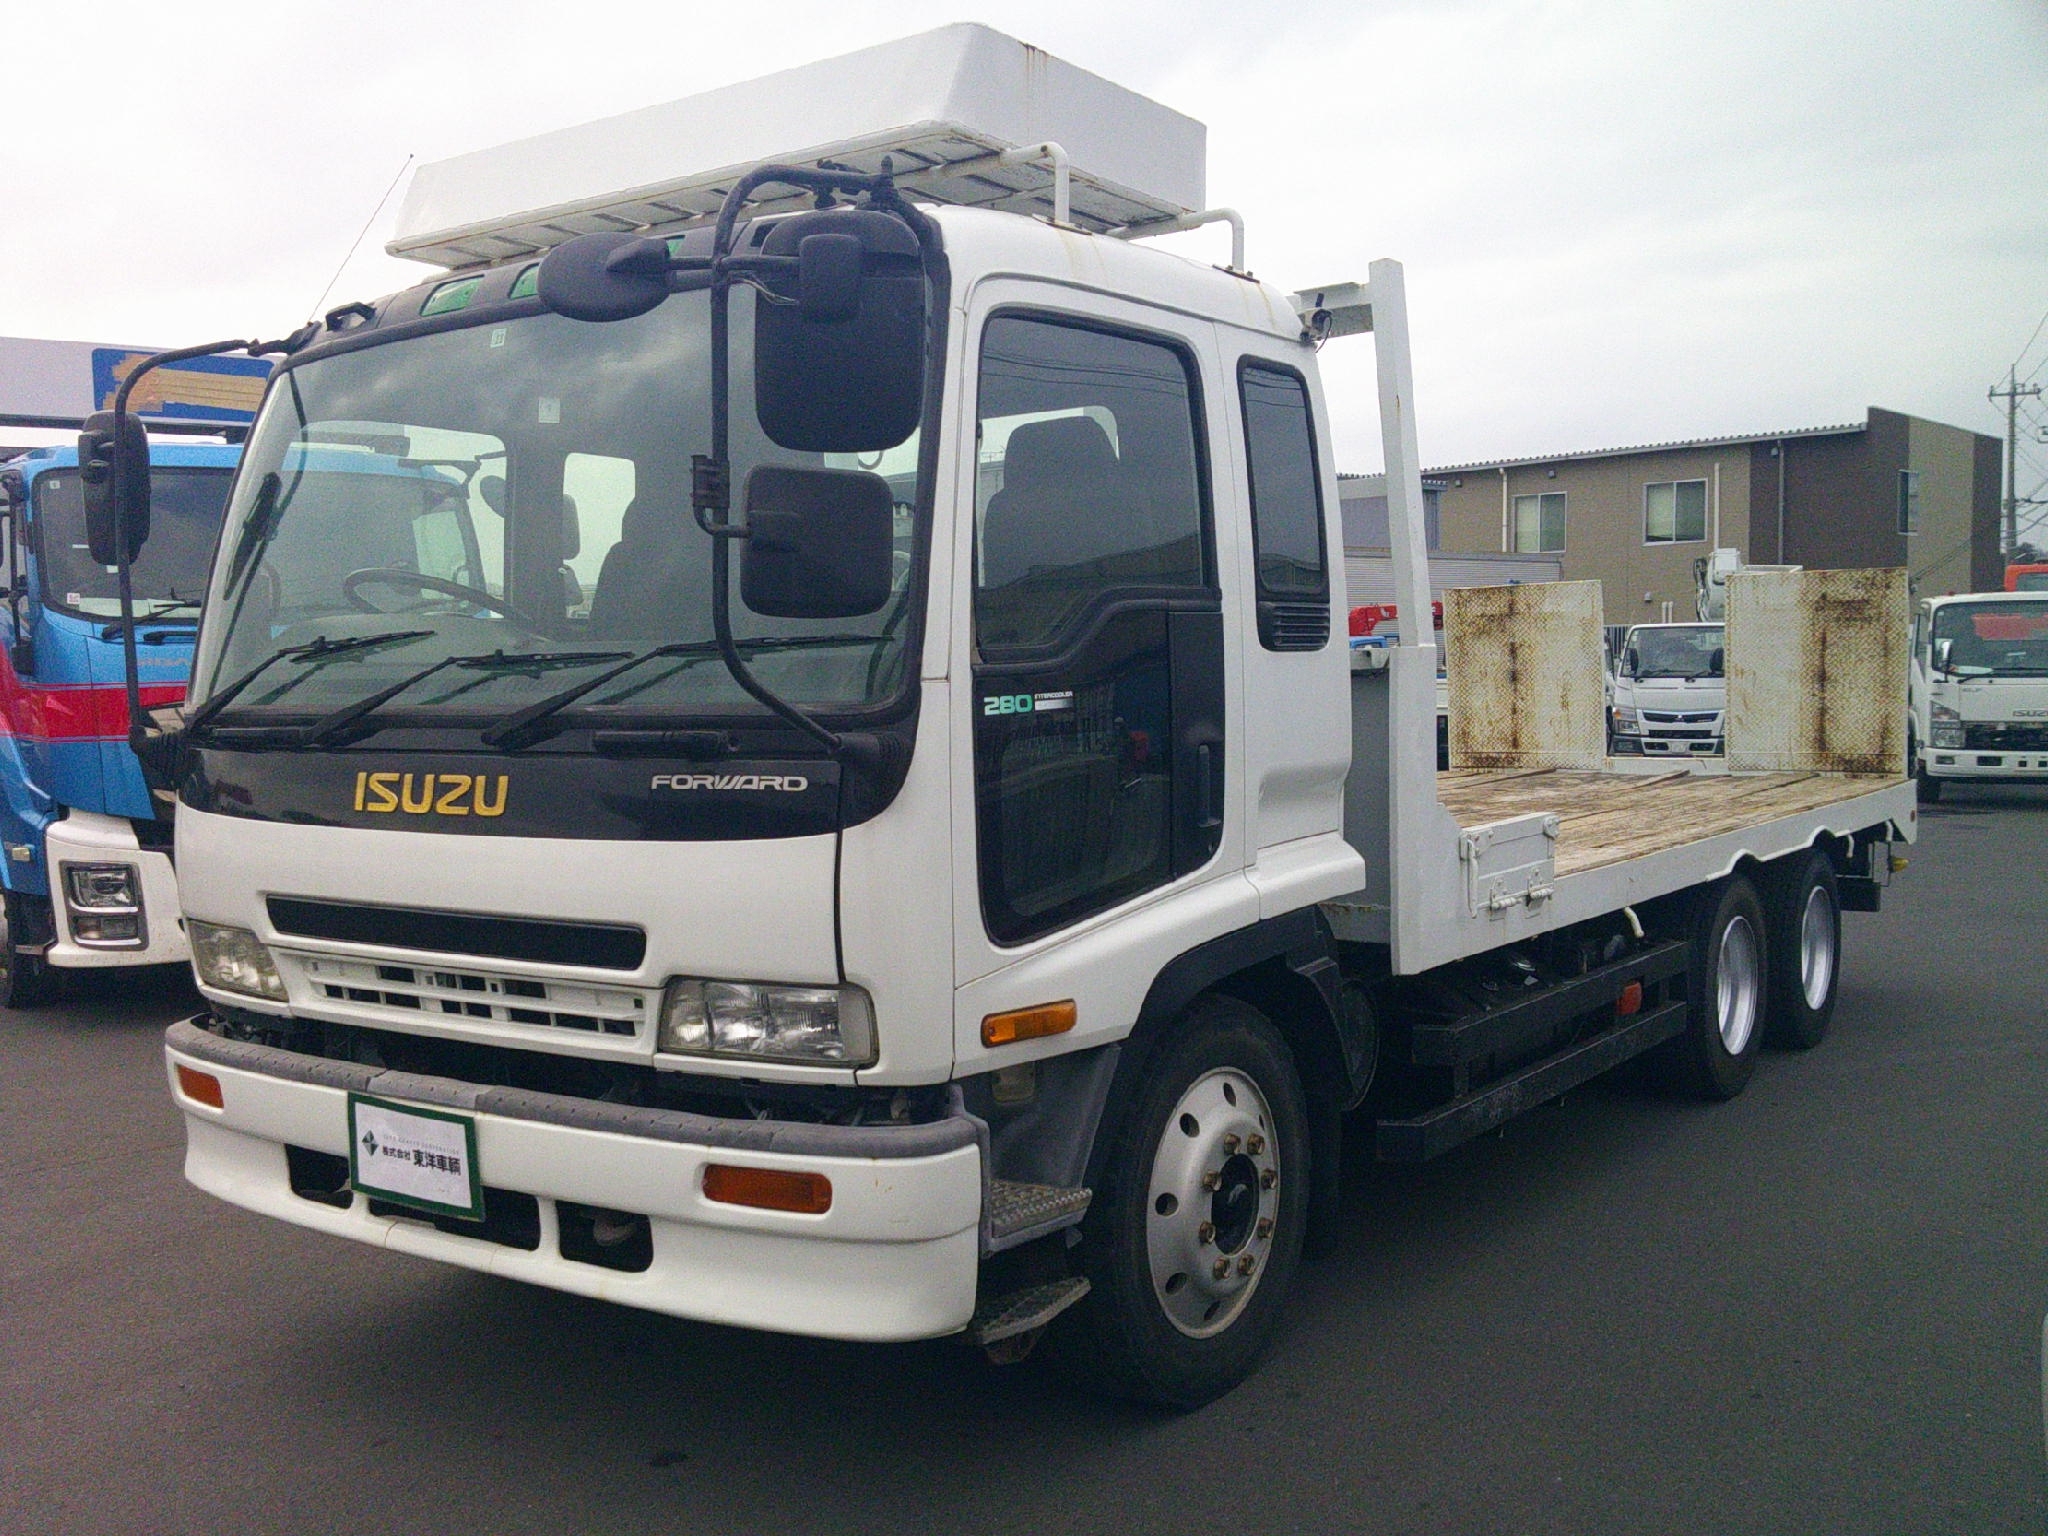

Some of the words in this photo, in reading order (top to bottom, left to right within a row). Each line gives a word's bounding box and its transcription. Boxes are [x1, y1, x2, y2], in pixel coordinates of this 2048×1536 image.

[983, 694, 1033, 716] 280
[2013, 709, 2048, 717] ISUZ
[651, 774, 808, 791] FORWARD
[354, 771, 509, 816] ISUZU
